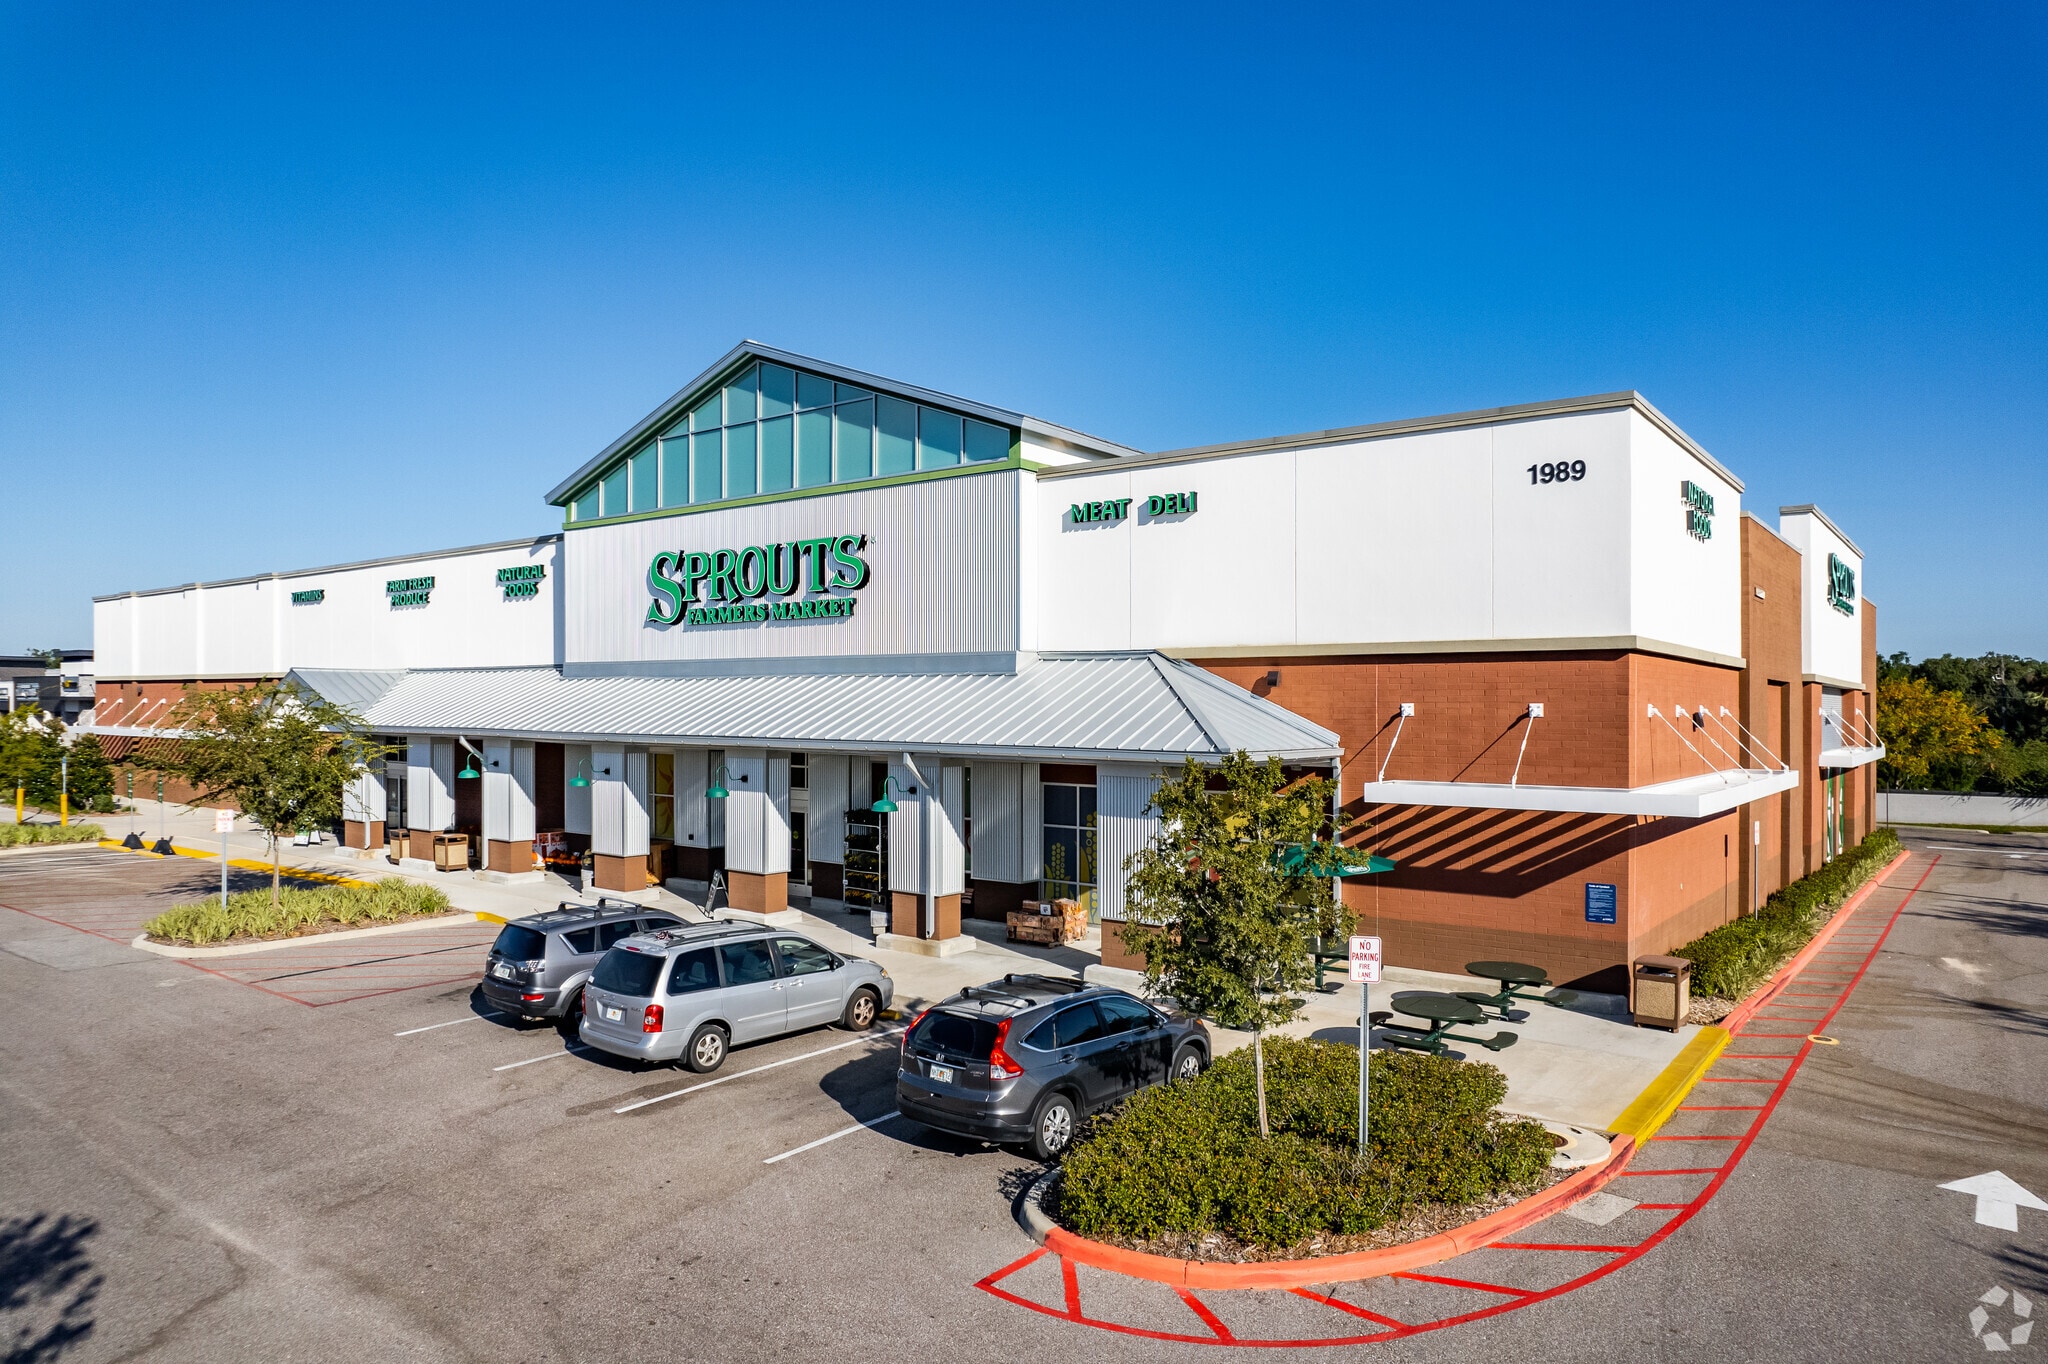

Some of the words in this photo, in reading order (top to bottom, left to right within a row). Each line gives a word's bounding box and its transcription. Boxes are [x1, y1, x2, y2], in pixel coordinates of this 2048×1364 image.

[1527, 460, 1586, 485] 1989
[1070, 498, 1131, 523] MEAT
[1147, 491, 1197, 516] DELI
[497, 564, 546, 582] NATURAL
[648, 534, 869, 625] SPROUTS
[386, 577, 408, 593] FARM
[409, 576, 435, 591] FRESH
[505, 581, 538, 598] FOODS
[291, 589, 324, 603] VITAMINS
[391, 591, 430, 607] PRODUCE
[687, 604, 768, 625] FARMERS
[771, 597, 856, 620] MARKET
[1359, 941, 1371, 951] NO
[1351, 952, 1379, 962] PARKING
